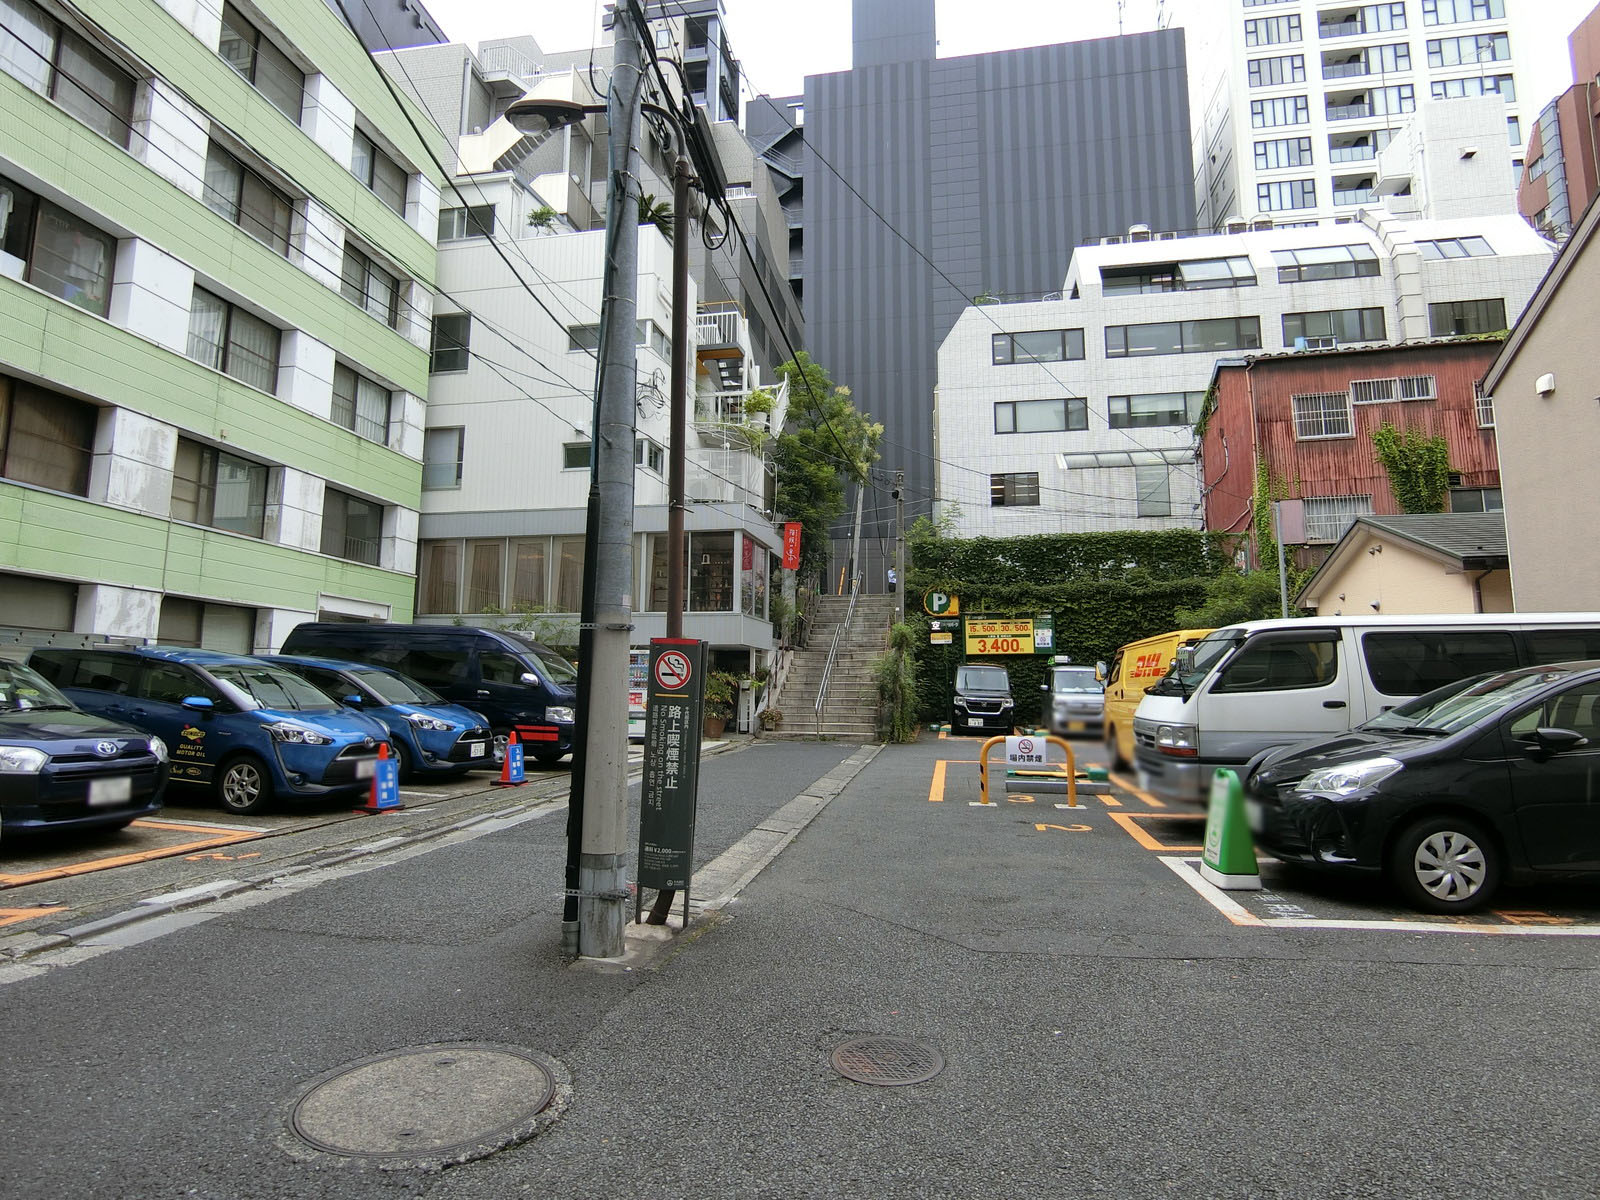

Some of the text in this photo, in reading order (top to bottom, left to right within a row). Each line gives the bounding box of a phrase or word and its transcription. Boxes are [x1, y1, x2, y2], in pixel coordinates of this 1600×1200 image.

[932, 593, 947, 611] P
[1014, 624, 1028, 632] 500
[176, 749, 195, 757] MOTOR
[664, 705, 682, 789] 路上喫煙禁止
[655, 704, 668, 811] No Smoking on the street
[1009, 754, 1043, 763] 場内禁煙
